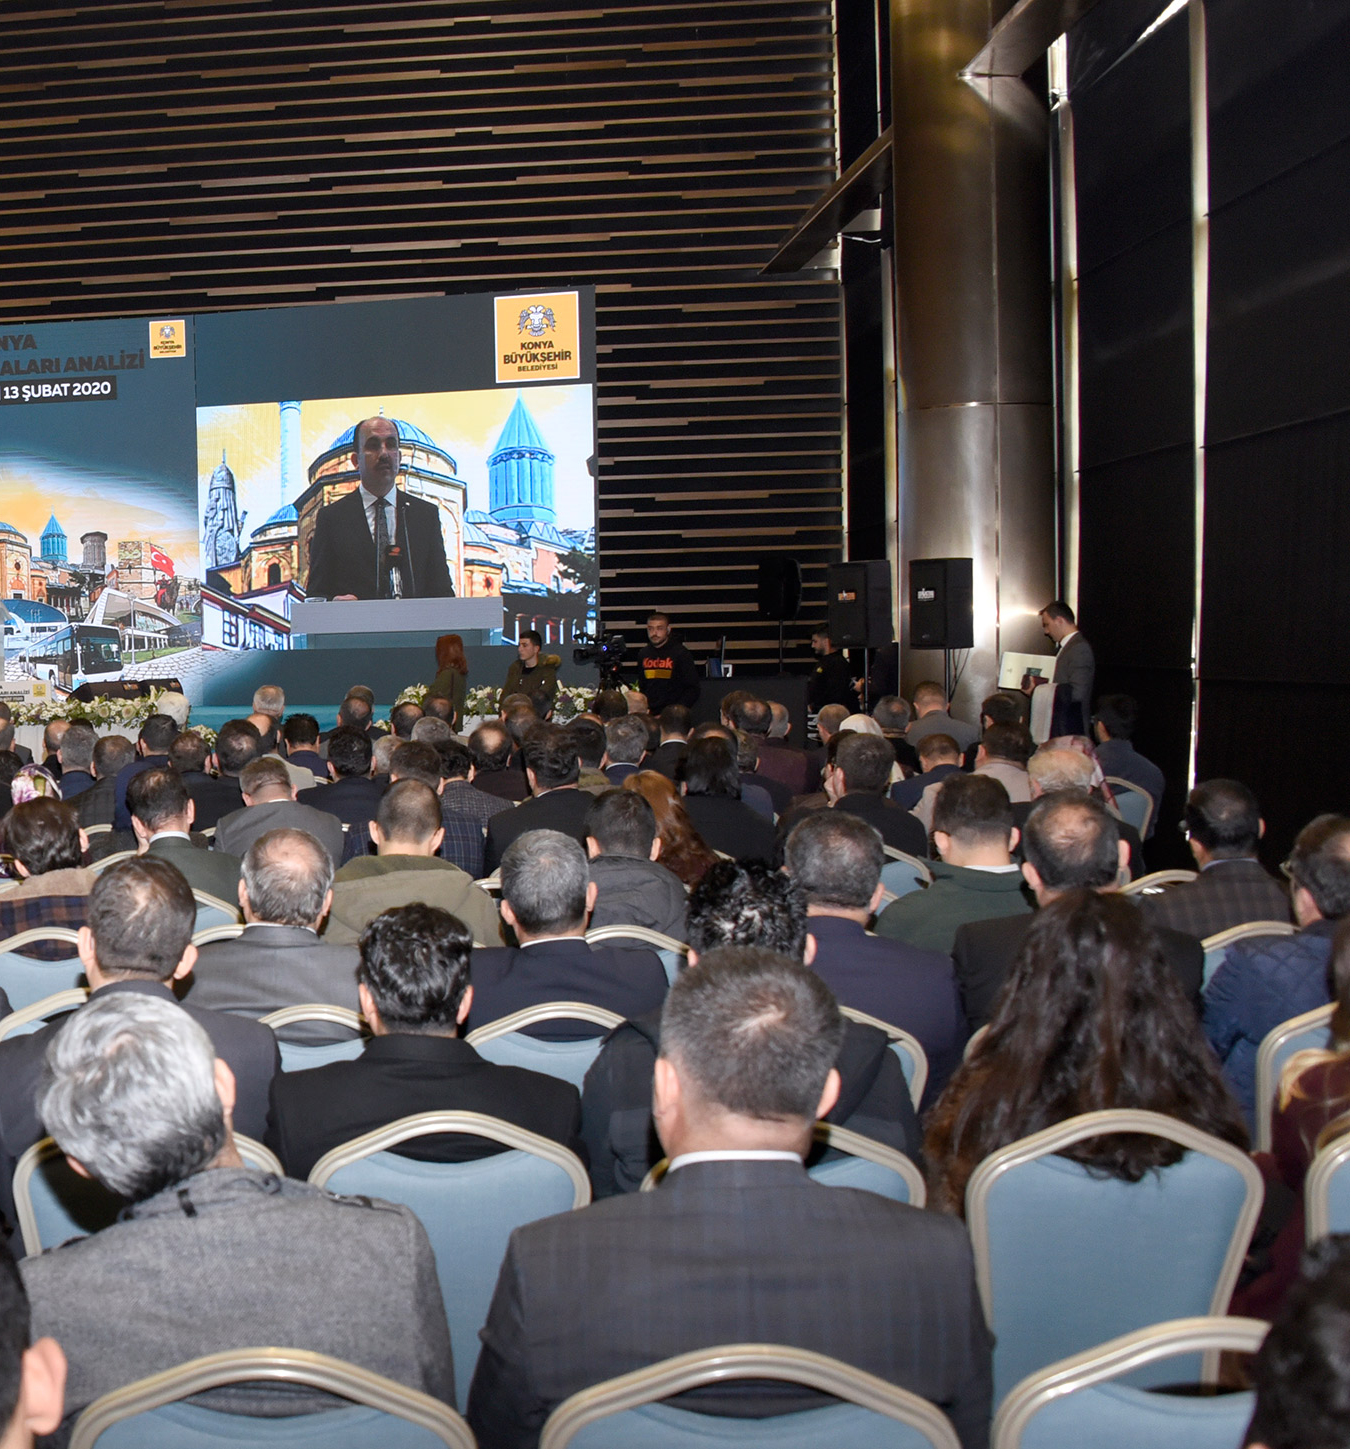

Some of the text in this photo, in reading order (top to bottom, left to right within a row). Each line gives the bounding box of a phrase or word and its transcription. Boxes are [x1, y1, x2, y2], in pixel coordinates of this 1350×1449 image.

[520, 340, 554, 350] KONYA
[63, 348, 145, 373] ANALİZİ
[503, 349, 572, 364] BÜYÜKŞEHİR
[3, 385, 20, 400] 13
[21, 382, 71, 402] ŞUBAT
[72, 381, 112, 396] 2020
